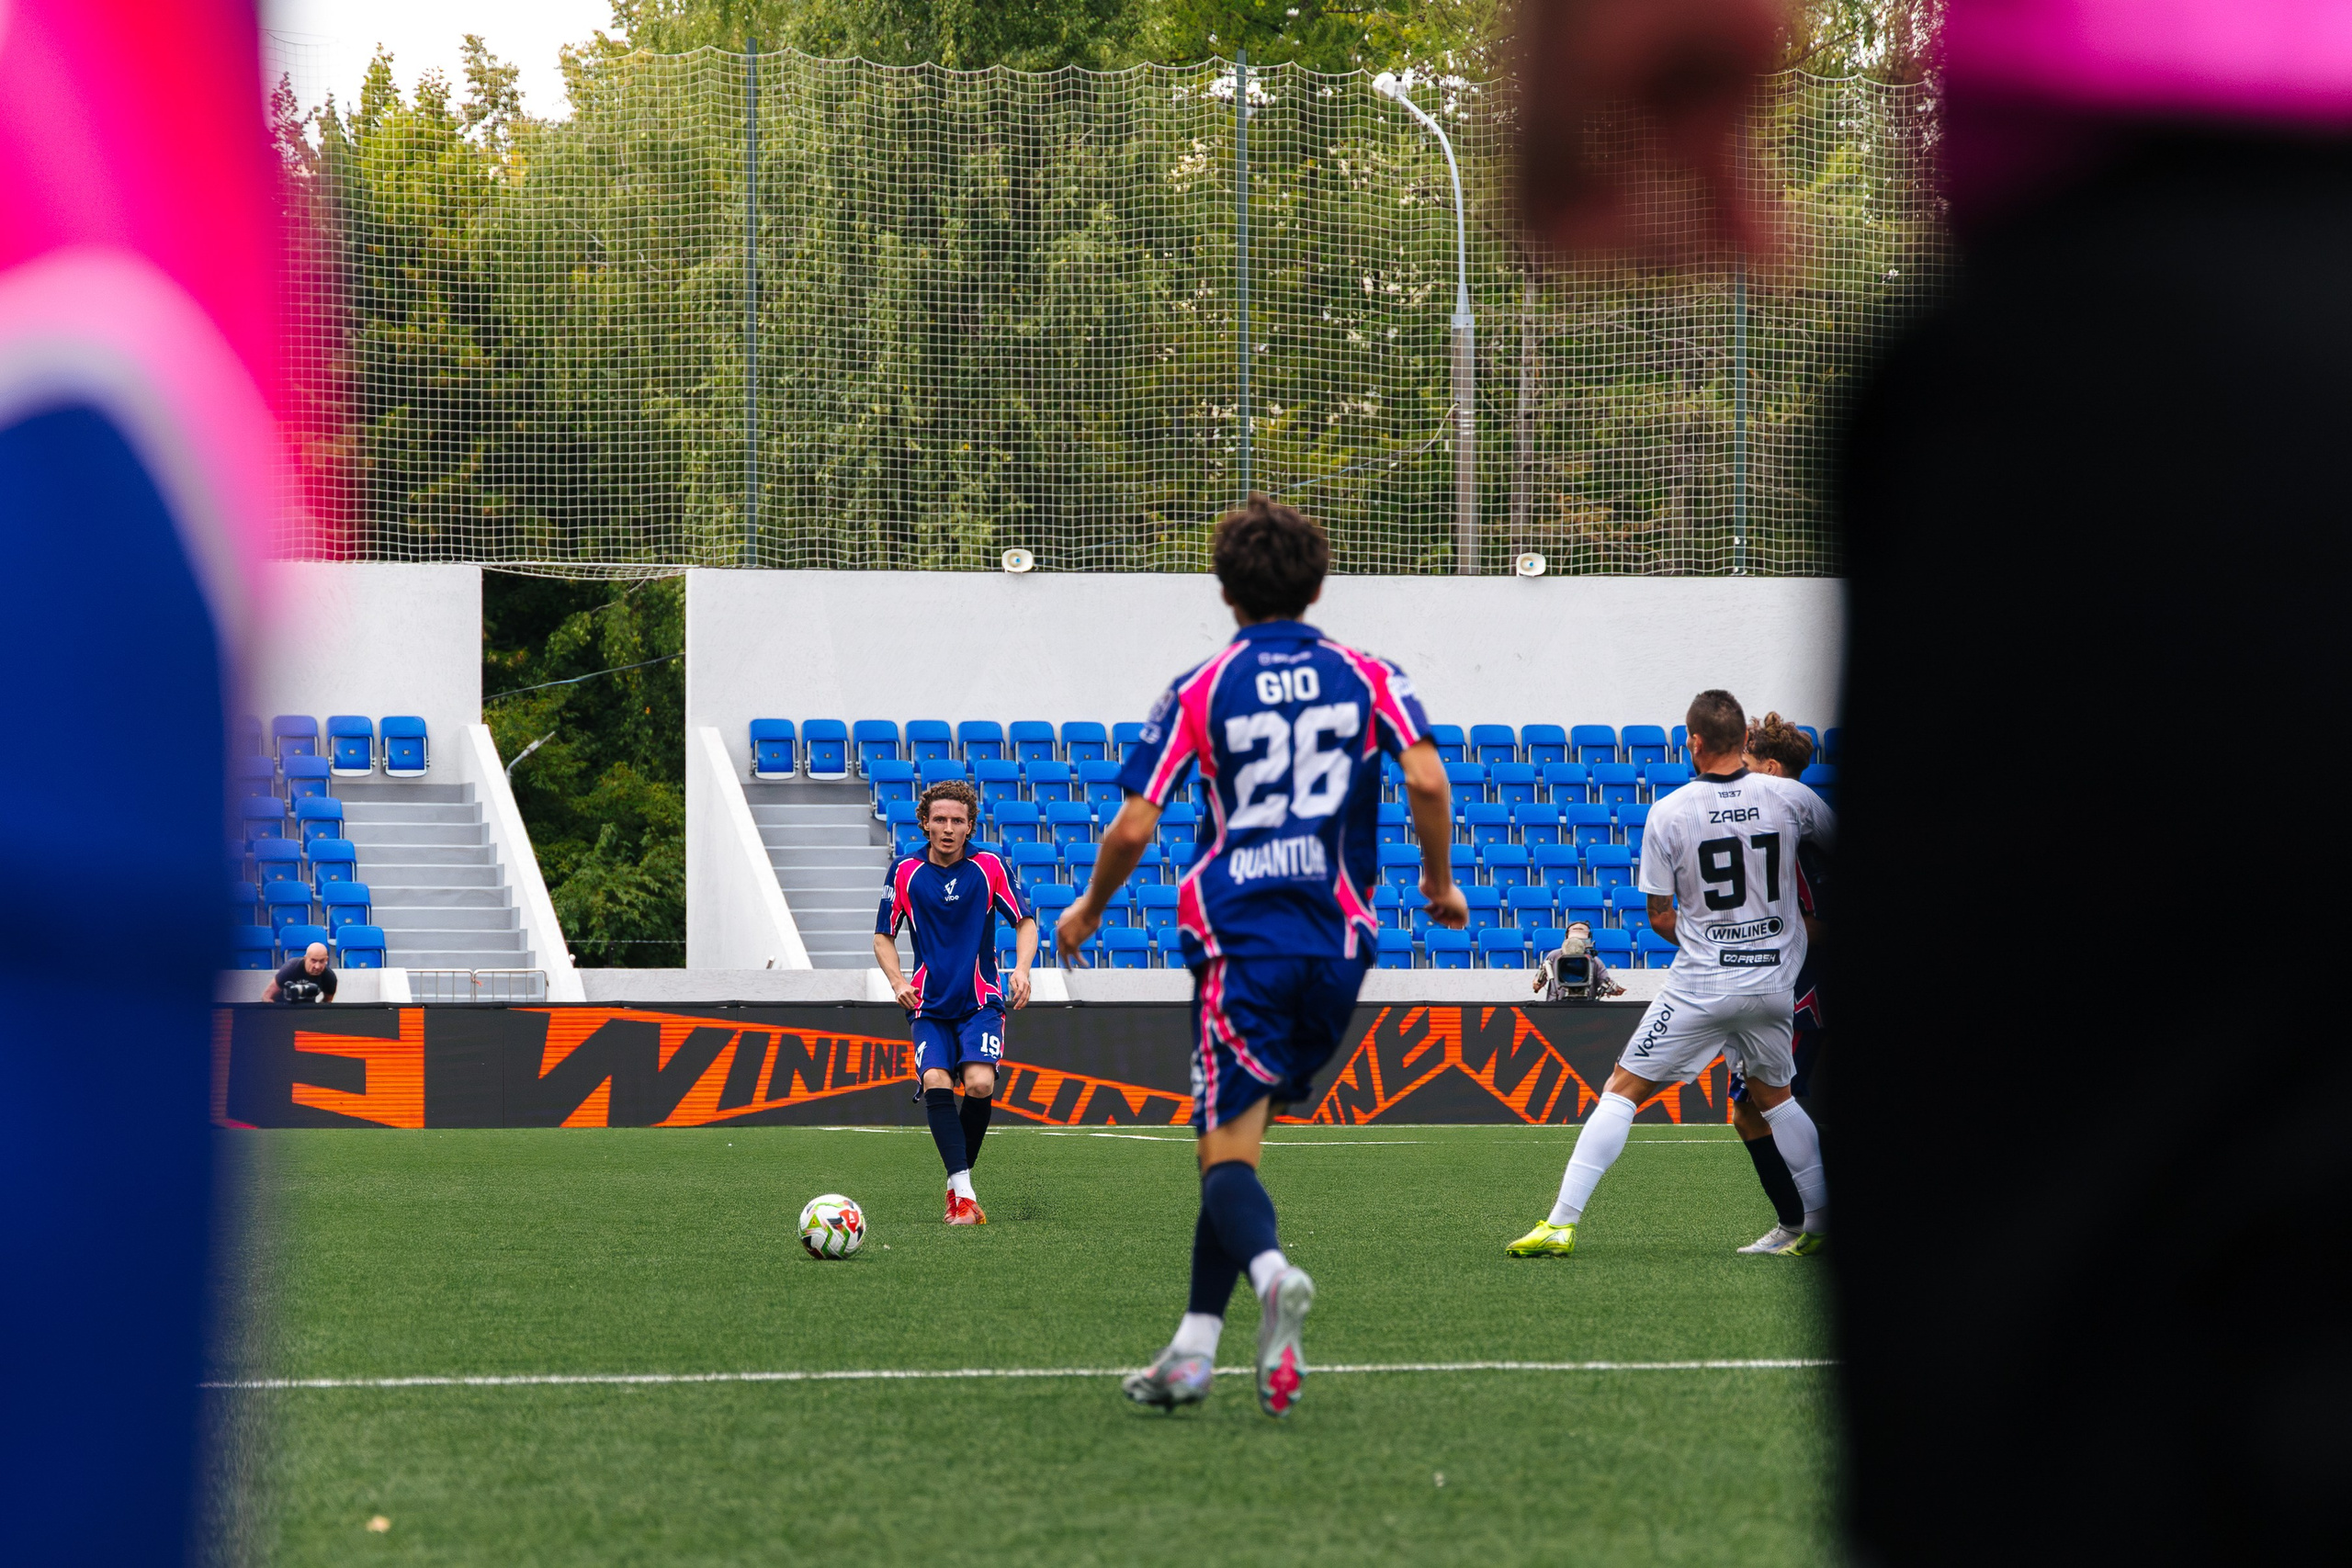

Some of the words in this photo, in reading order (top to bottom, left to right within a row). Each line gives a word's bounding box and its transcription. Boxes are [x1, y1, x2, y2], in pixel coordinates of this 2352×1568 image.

[1255, 666, 1320, 705] GIO
[1225, 702, 1360, 829] 26
[1717, 789, 1742, 798] 1937
[1708, 807, 1760, 824] ZABA
[1698, 831, 1781, 911] 91
[1712, 922, 1768, 940] WINLINE
[980, 1032, 1001, 1056] 19
[1634, 1002, 1677, 1059] Vorgol
[459, 1009, 908, 1128] WINLINE
